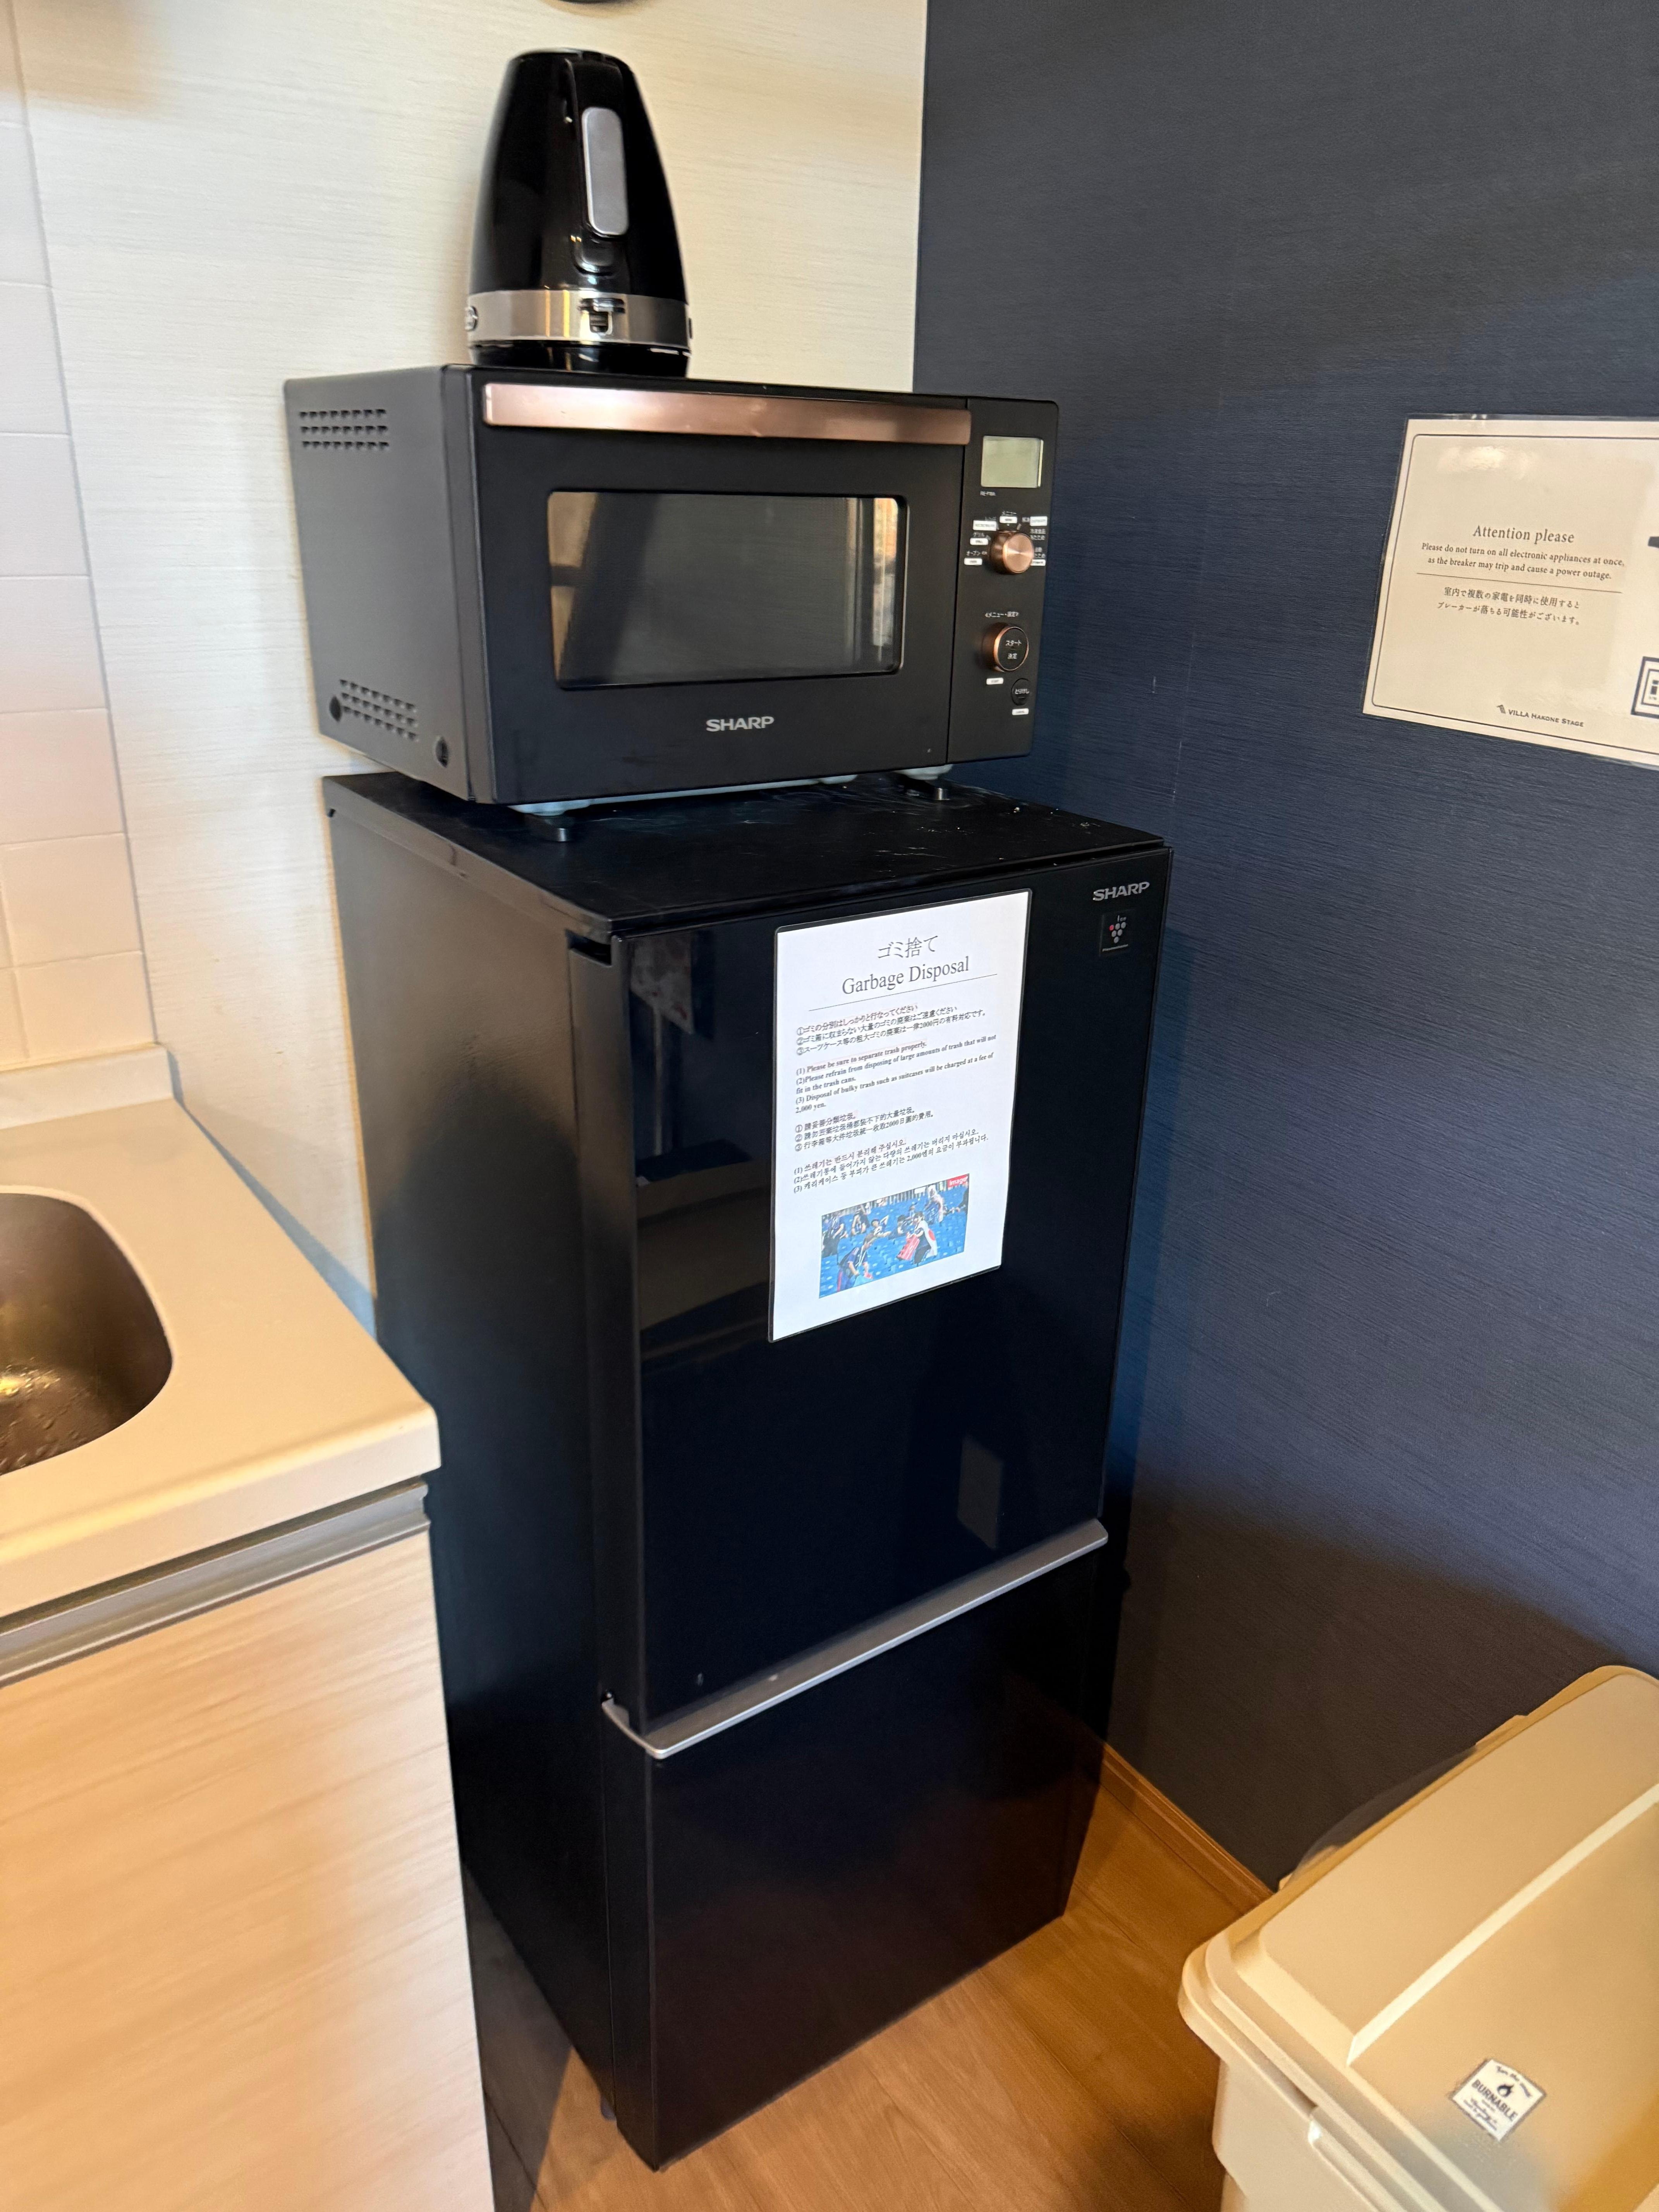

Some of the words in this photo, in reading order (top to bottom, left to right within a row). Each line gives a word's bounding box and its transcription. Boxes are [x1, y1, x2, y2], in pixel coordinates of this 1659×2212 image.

[1472, 525, 1530, 540] Attention
[1534, 528, 1575, 545] please
[1422, 542, 1443, 551] Please
[1444, 544, 1453, 552] do
[1498, 548, 1508, 556] all
[1510, 549, 1547, 560] electronic
[1549, 553, 1591, 563] appliances
[1437, 556, 1448, 565] the
[1449, 557, 1477, 567] breaker
[1478, 562, 1494, 570] may
[1495, 562, 1509, 572] trip
[1511, 563, 1525, 572] and
[1556, 568, 1581, 577] power
[1583, 571, 1611, 581] outage.
[706, 716, 775, 732] SHARP
[1092, 881, 1150, 901] SHARP
[878, 935, 938, 958] ゴミ捨て
[842, 973, 904, 994] Garbage
[908, 956, 969, 982] Disposal
[796, 1068, 805, 1076] (1)
[807, 1064, 826, 1073] Please
[858, 1052, 883, 1061] separate
[884, 1047, 900, 1055] trash
[901, 1041, 927, 1053] properly.
[825, 1068, 847, 1078] refrain
[864, 1059, 892, 1069] disposing
[916, 1048, 940, 1057] amounts
[948, 1042, 963, 1050] trash
[795, 1097, 804, 1105] (3)
[806, 1090, 832, 1102] Disposal
[841, 1085, 858, 1093] bulky
[860, 1080, 875, 1089] trash
[876, 1077, 890, 1085] such
[898, 1070, 923, 1080] suitcases
[944, 1058, 966, 1069] charged
[823, 1079, 839, 1088] trash
[813, 1103, 826, 1111] yen.
[1472, 2079, 1518, 2122] BURNABLE
